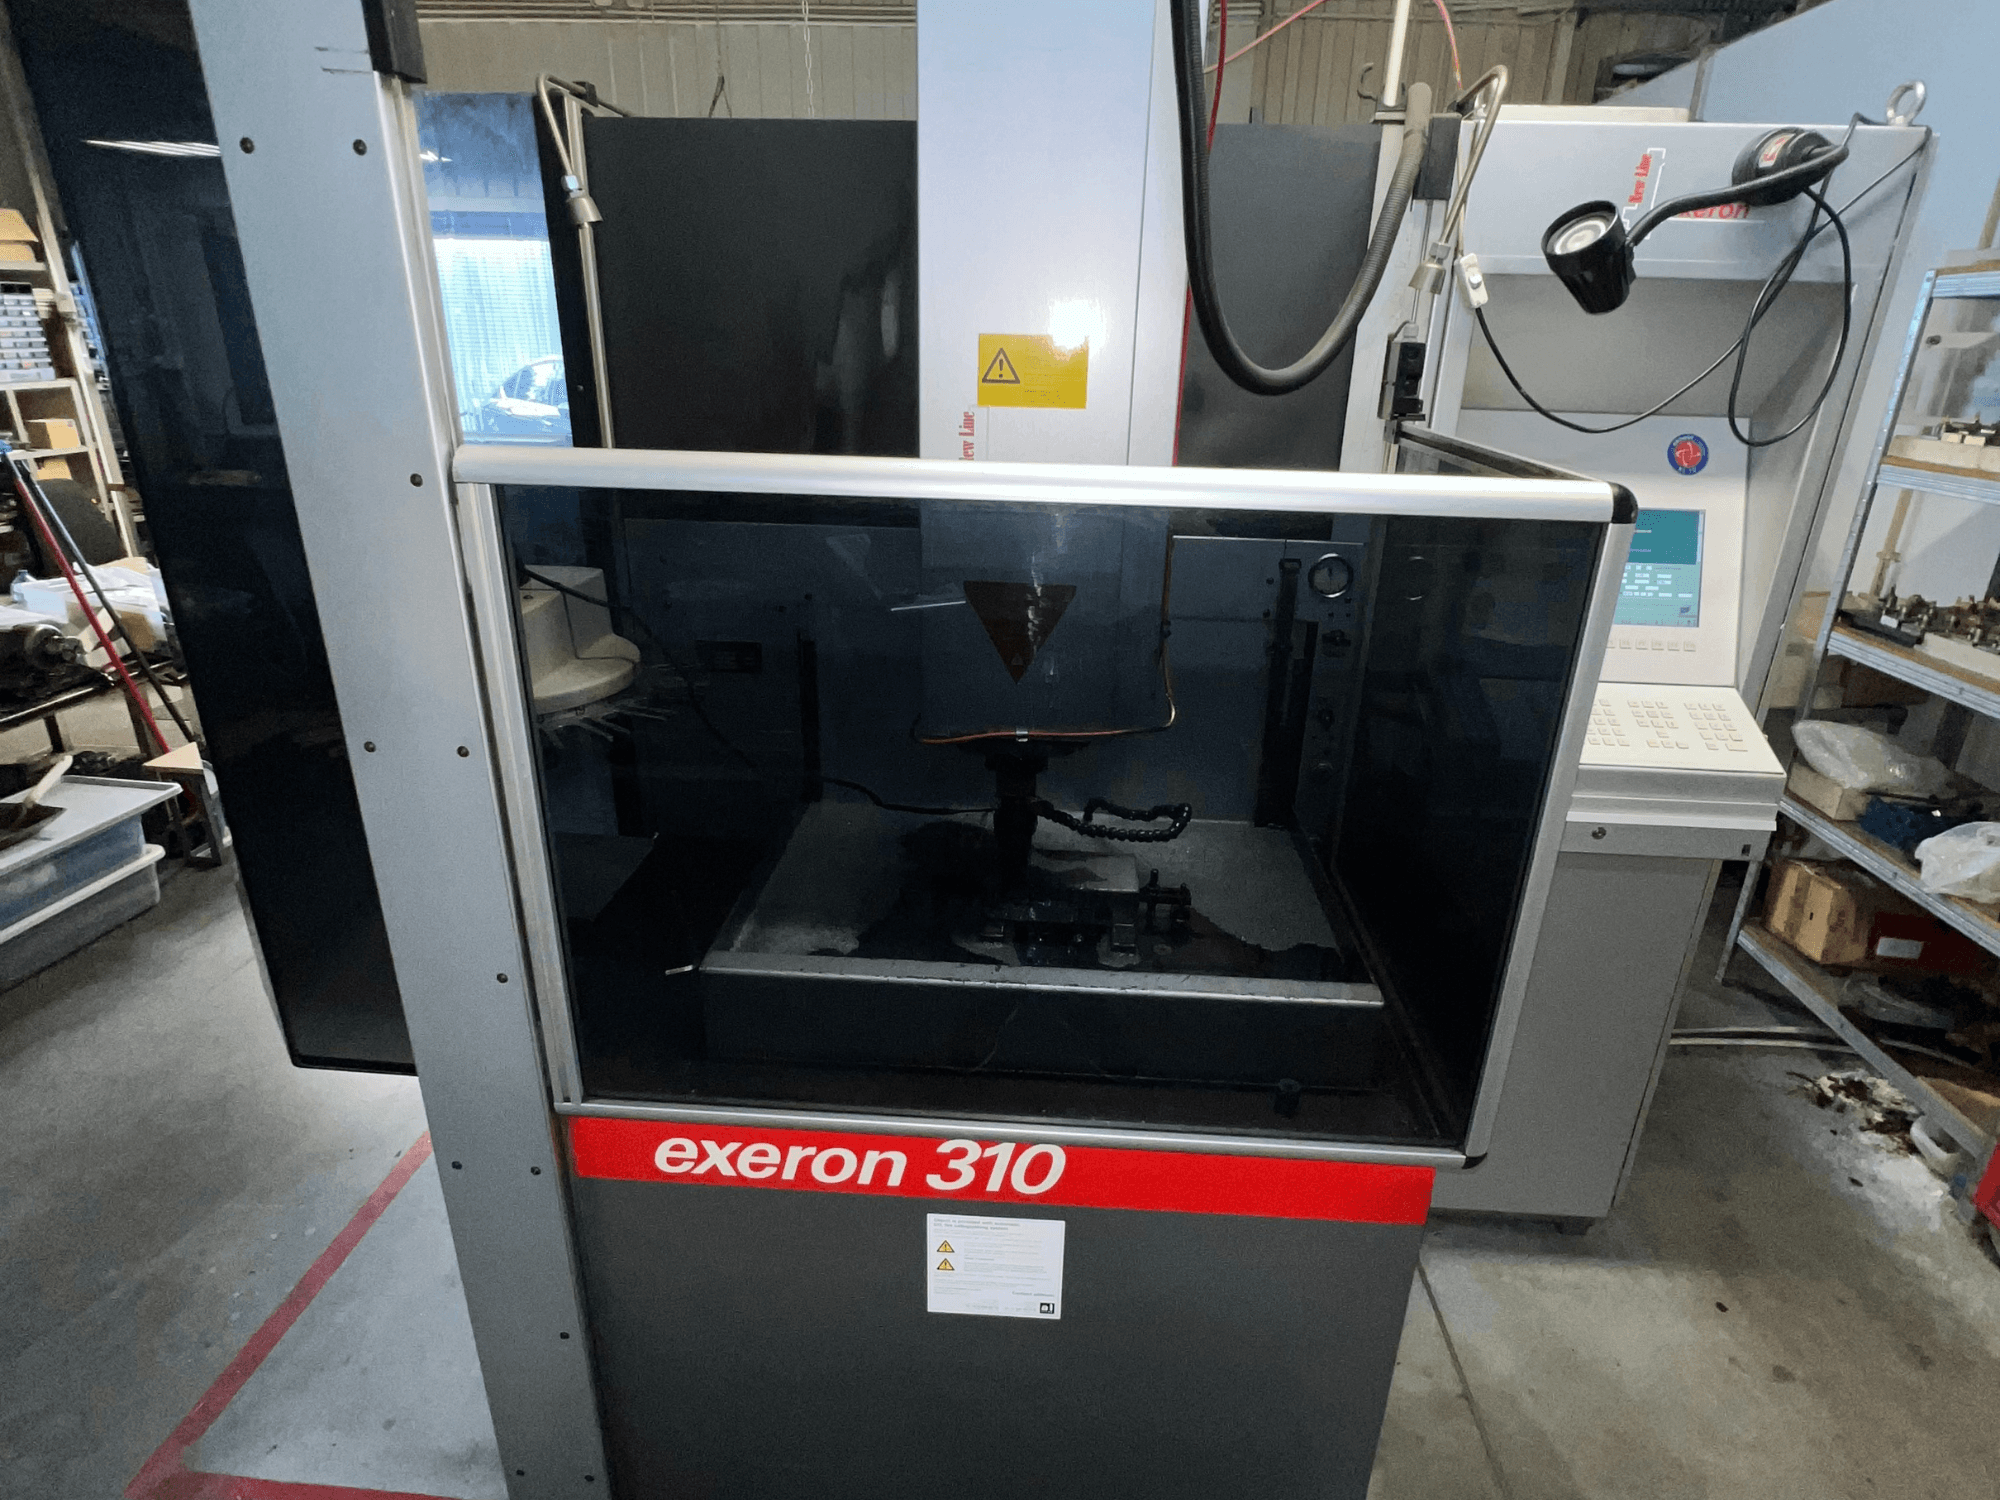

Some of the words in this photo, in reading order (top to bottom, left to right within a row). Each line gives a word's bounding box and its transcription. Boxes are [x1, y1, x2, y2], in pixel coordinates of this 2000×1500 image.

[958, 411, 975, 437] Line
[958, 440, 975, 461] ew
[653, 1136, 908, 1187] exeron
[925, 1138, 1067, 1194] 310
